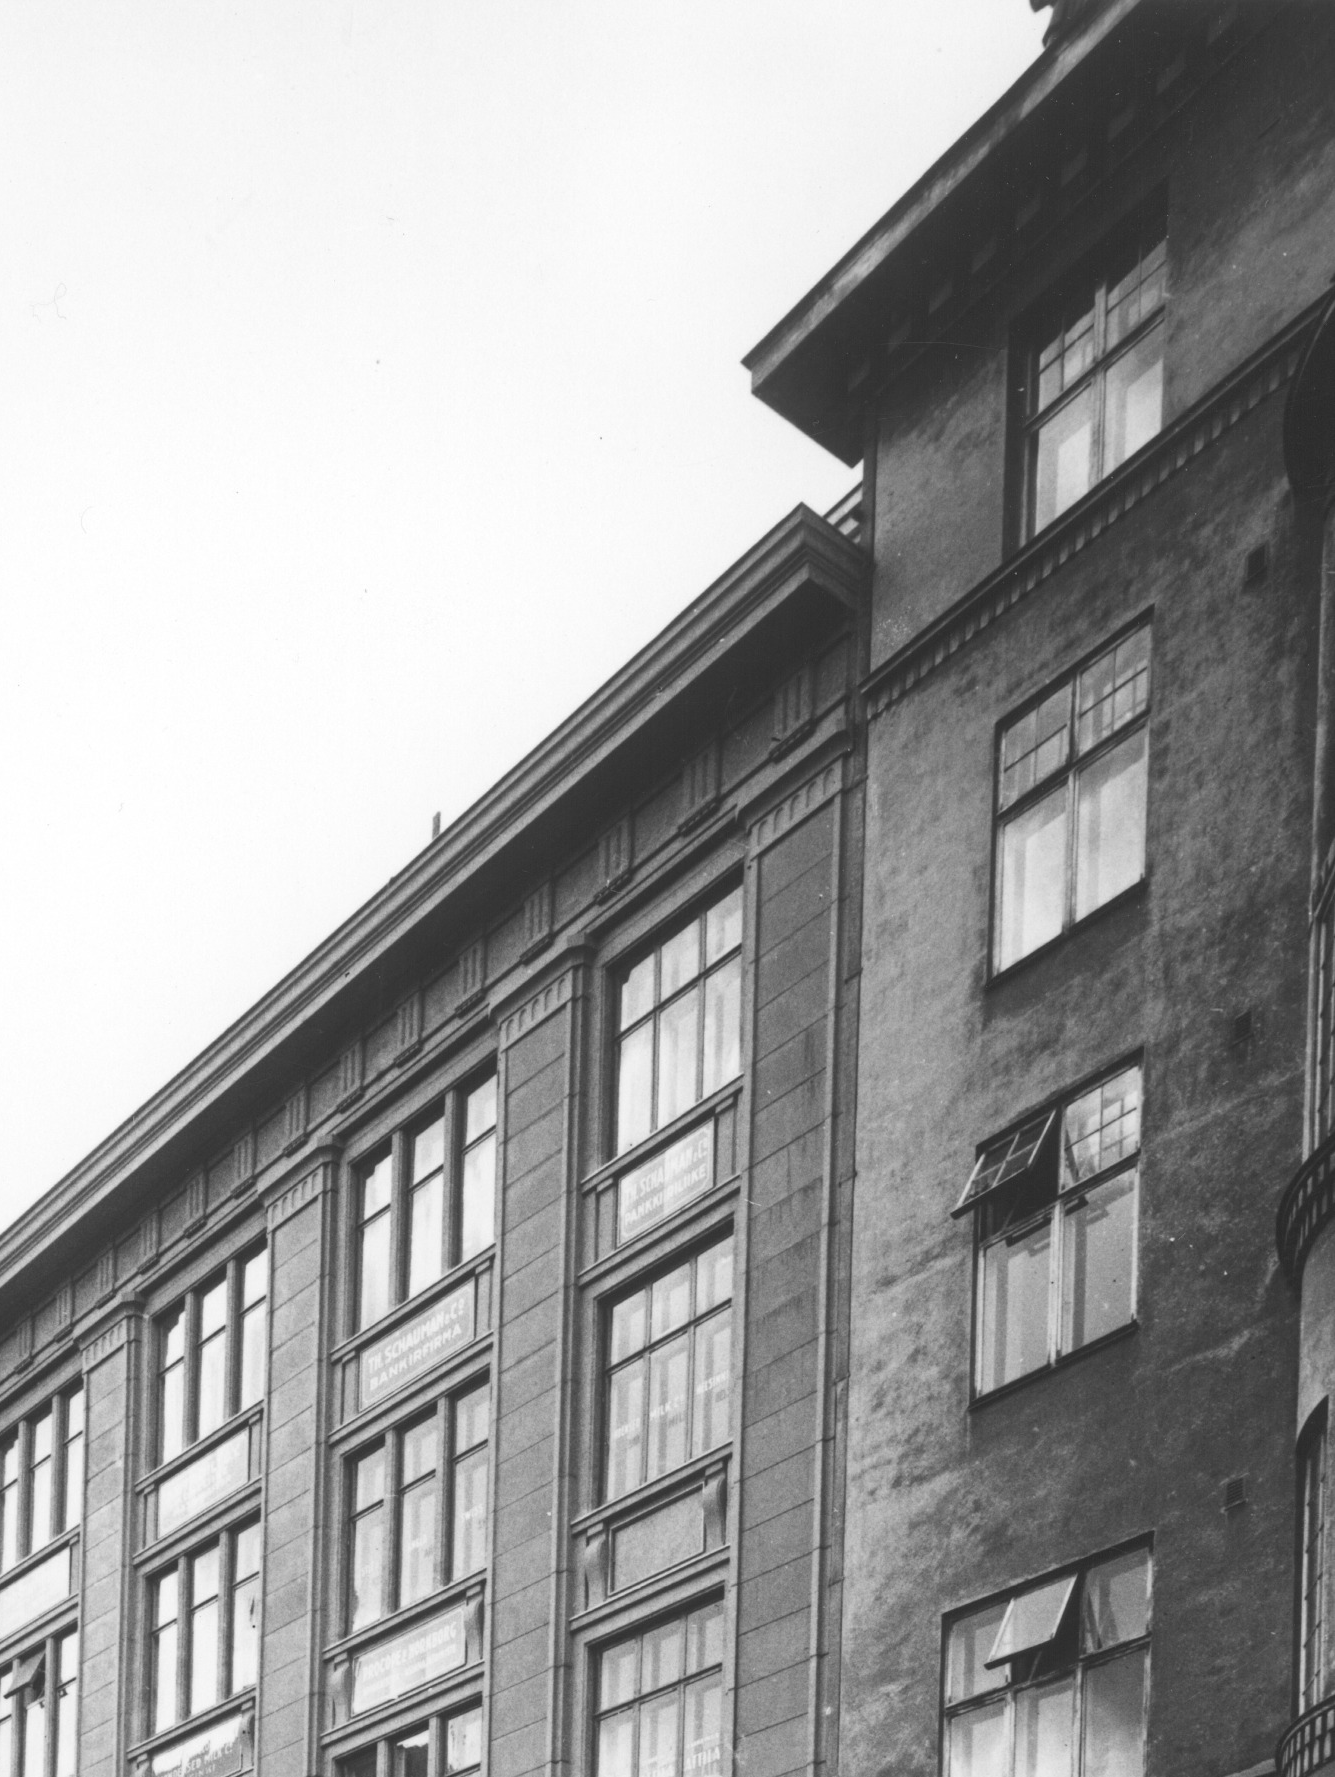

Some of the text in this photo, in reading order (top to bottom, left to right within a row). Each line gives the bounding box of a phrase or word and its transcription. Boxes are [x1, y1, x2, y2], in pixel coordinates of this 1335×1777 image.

[640, 1146, 693, 1197] SCHAMAN
[369, 1323, 462, 1391] BANKIRFIRMA
[384, 1311, 445, 1365] SCHAUMAN
